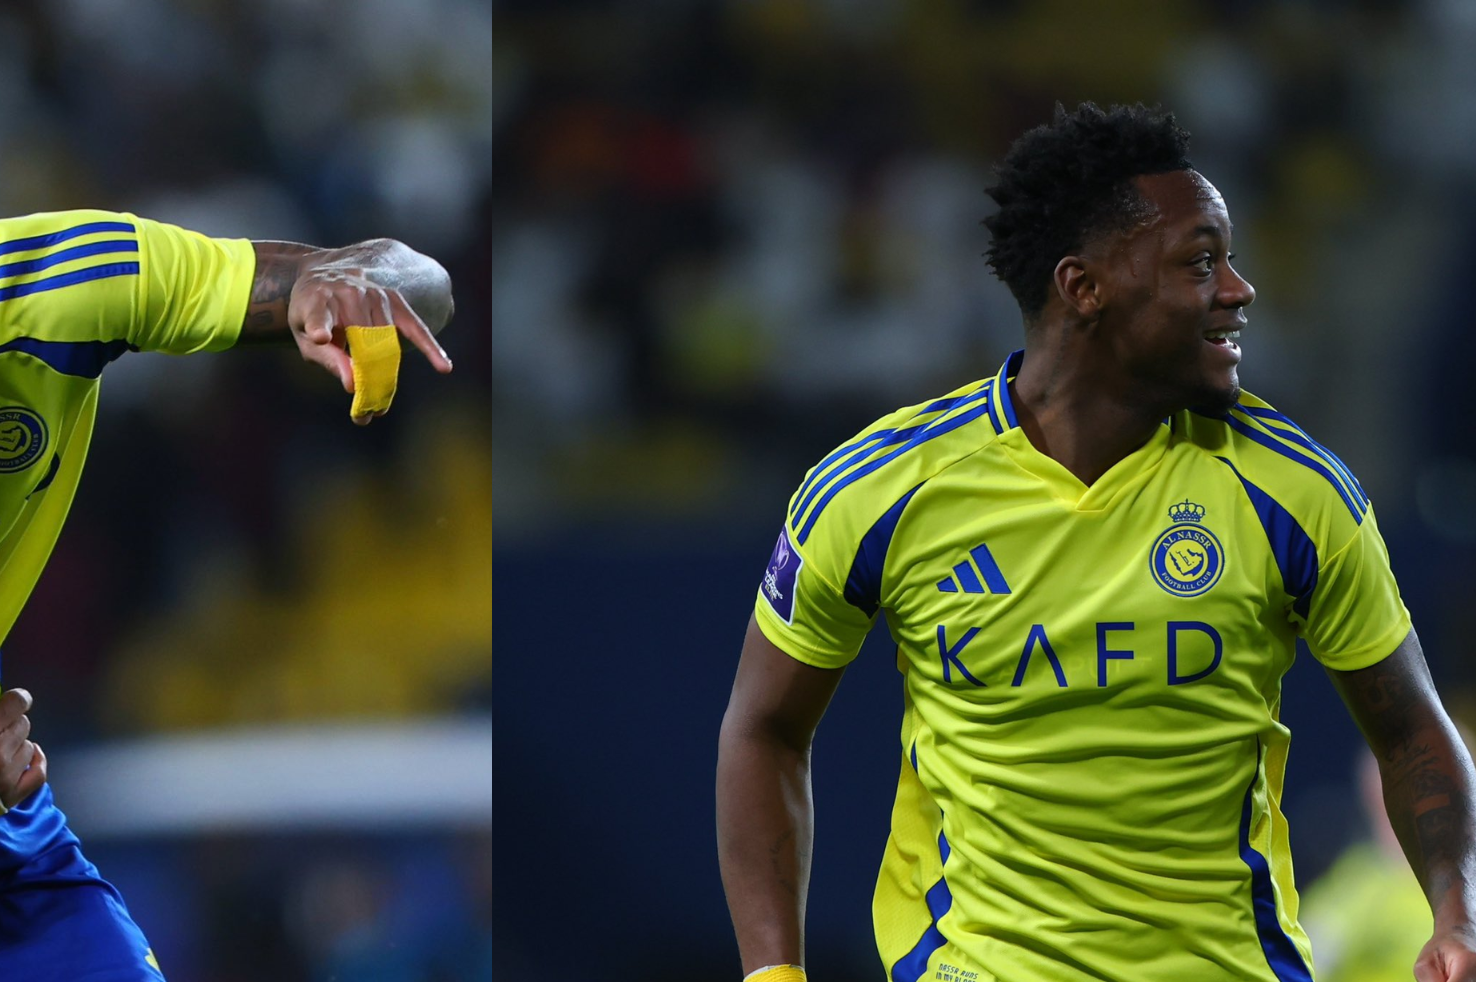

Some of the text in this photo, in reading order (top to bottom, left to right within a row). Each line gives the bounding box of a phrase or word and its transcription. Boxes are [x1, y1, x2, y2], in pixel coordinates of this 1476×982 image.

[1161, 531, 1212, 550] AL NASSR
[1161, 571, 1212, 590] FOOTBALL CLUB
[936, 621, 1223, 687] KAFD
